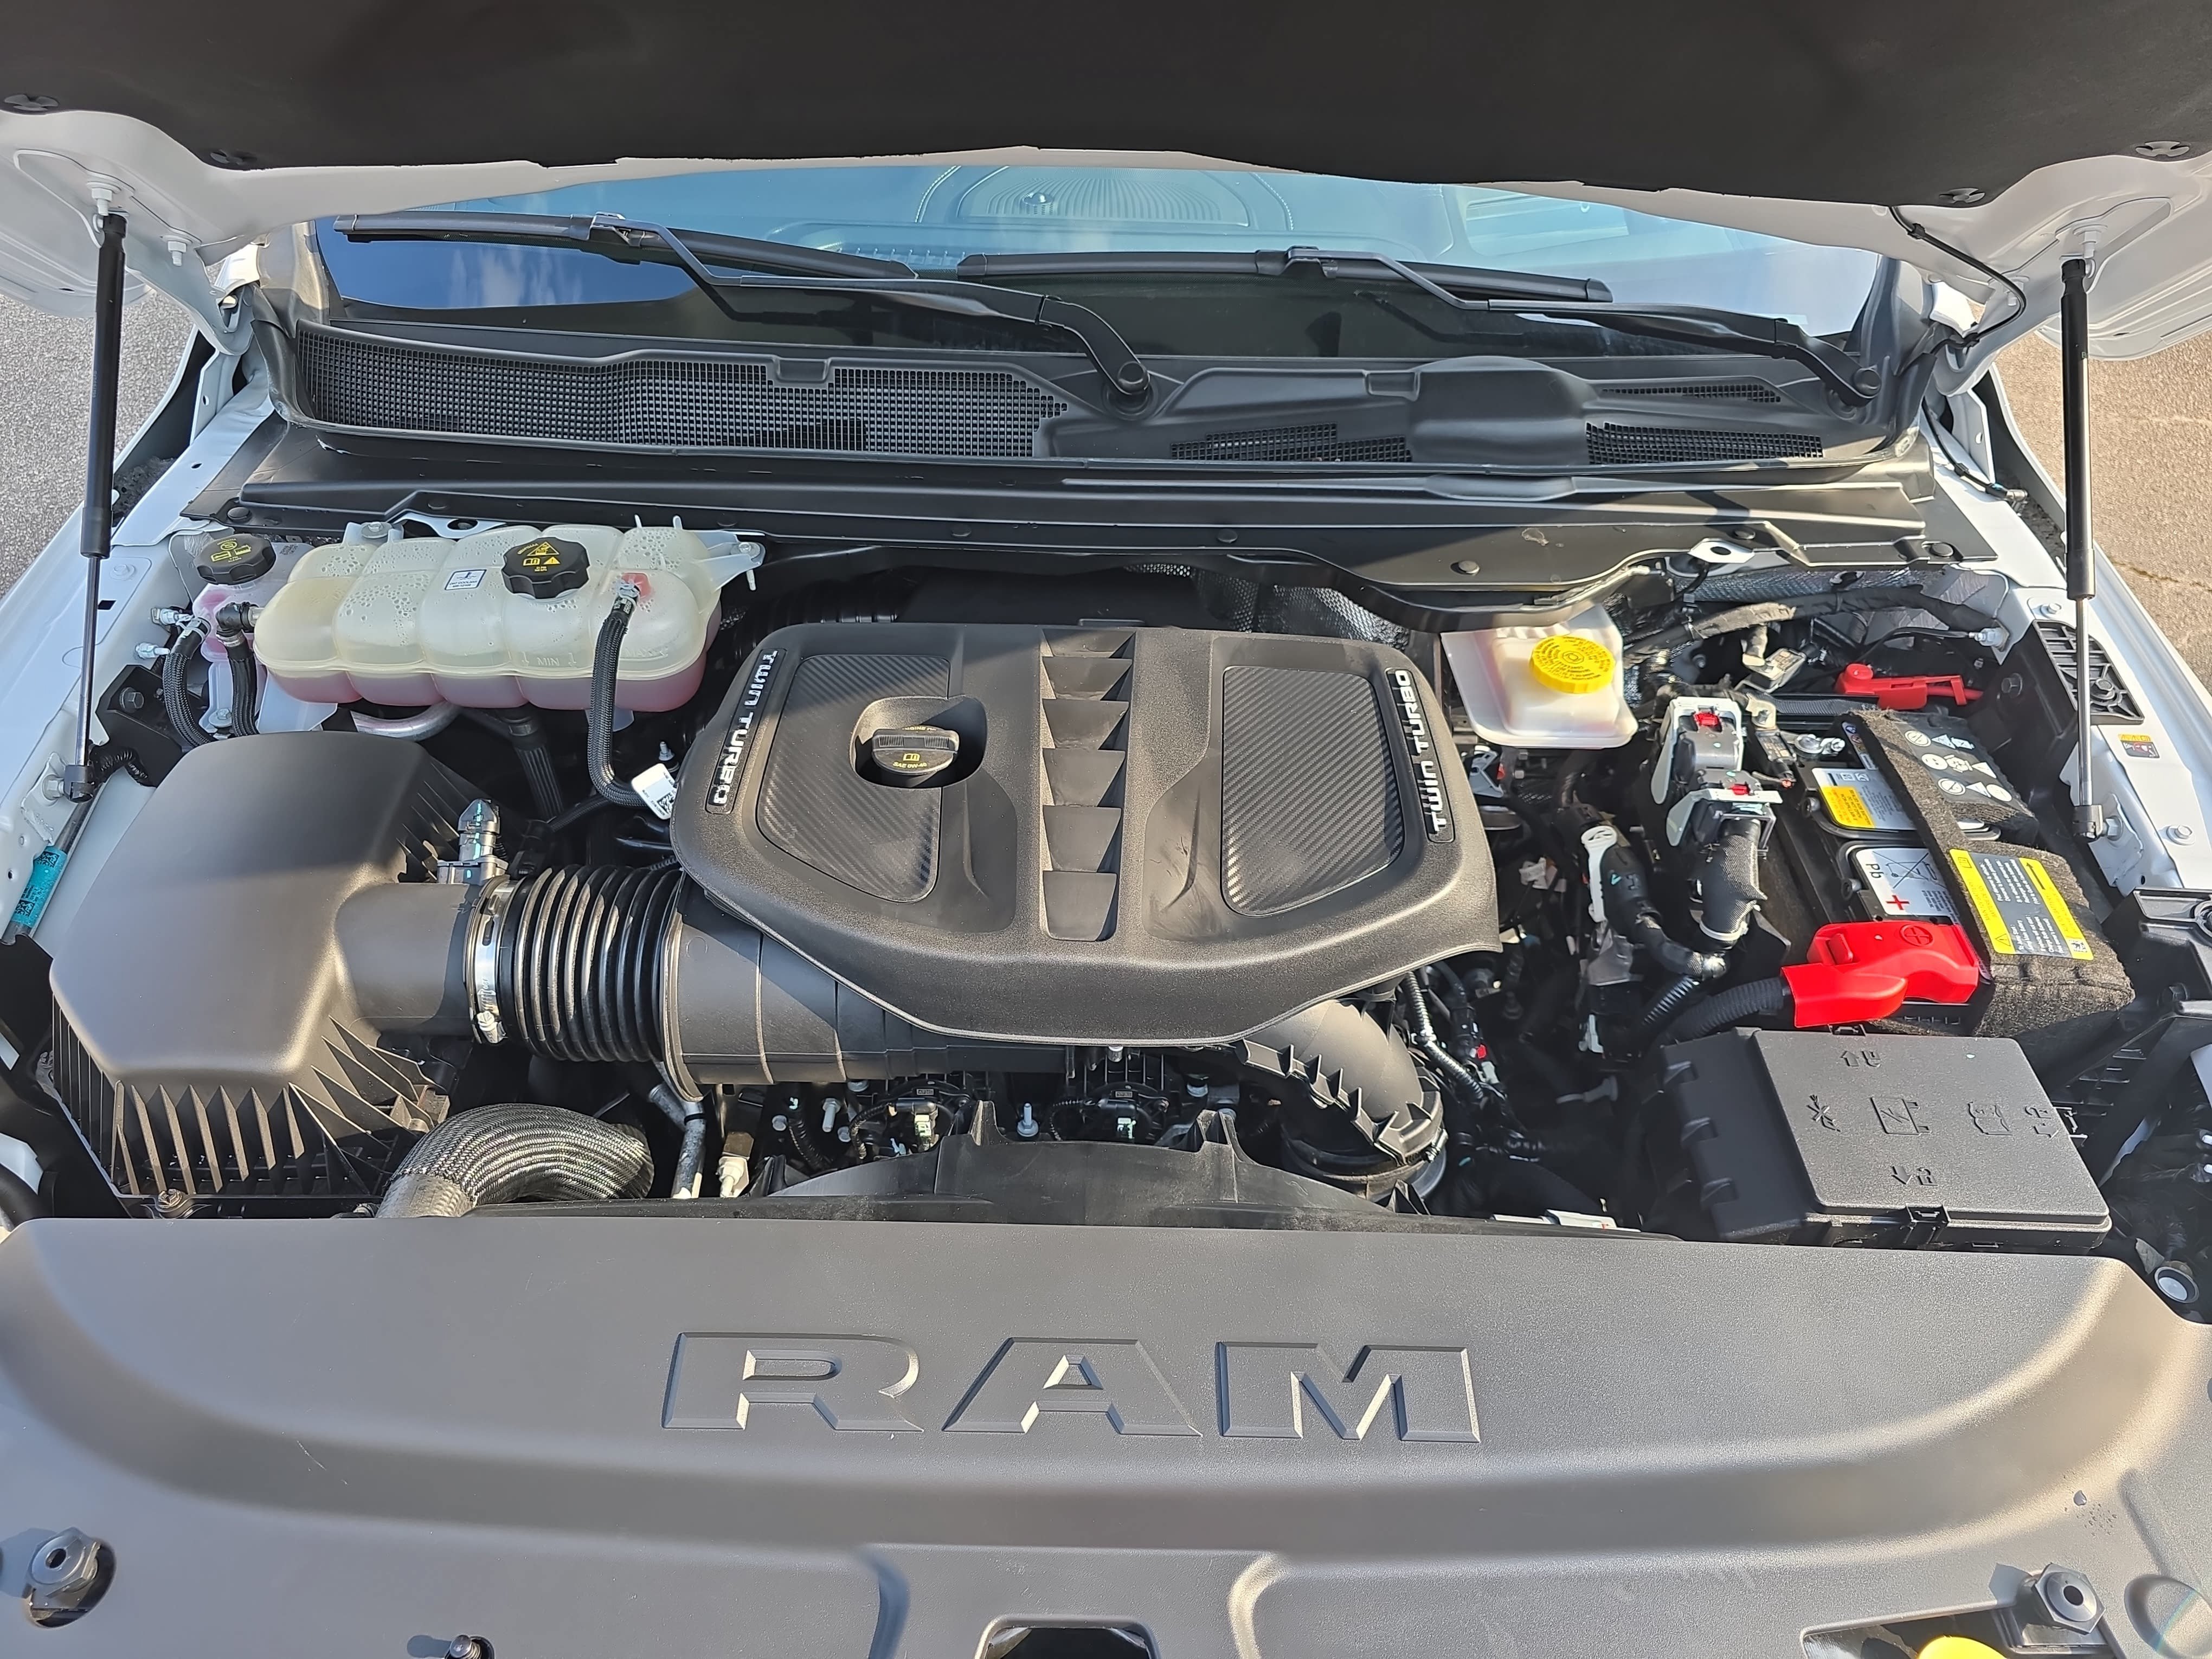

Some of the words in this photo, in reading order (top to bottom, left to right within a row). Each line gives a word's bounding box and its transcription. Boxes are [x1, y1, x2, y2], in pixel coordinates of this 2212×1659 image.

[537, 657, 560, 666] MIN
[744, 650, 778, 706] TWIN
[1395, 670, 1429, 755] TURBO
[713, 711, 754, 805] TURBO
[1421, 761, 1447, 832] TWIN
[1865, 863, 1886, 879] Pb
[2012, 935, 2025, 945] Jump
[663, 1332, 1481, 1444] RAM
